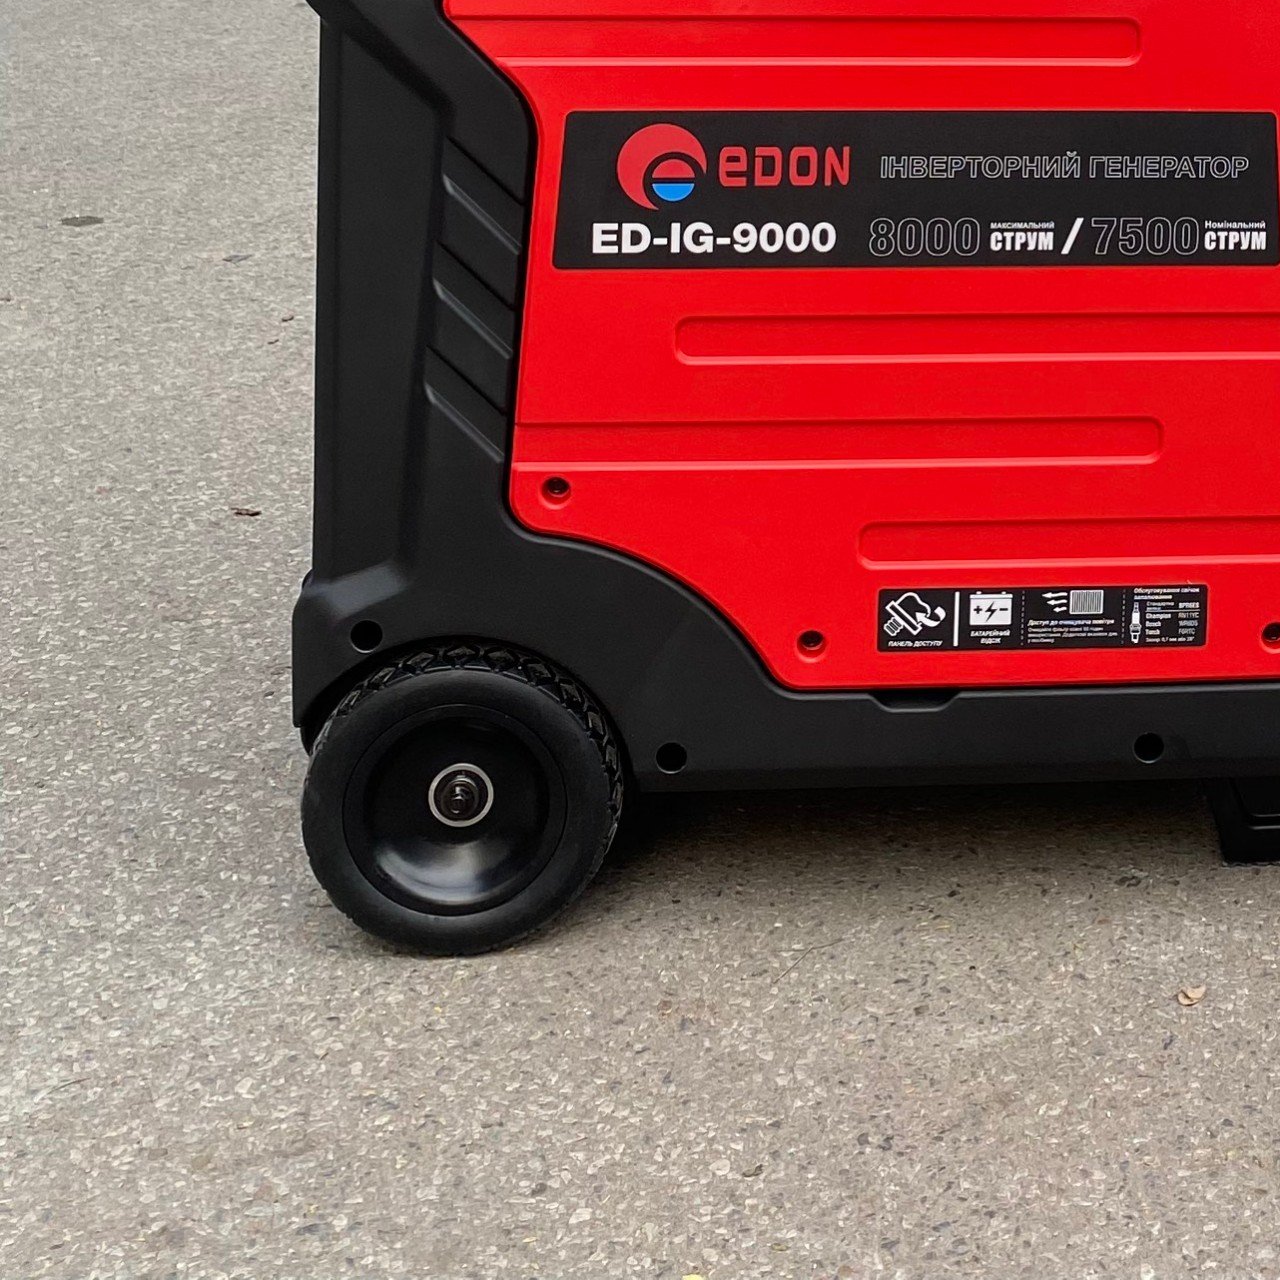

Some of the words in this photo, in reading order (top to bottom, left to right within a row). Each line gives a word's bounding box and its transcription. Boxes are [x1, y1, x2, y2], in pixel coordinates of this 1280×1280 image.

[880, 150, 1081, 179] ІНВЕРТОРНИЙ
[1088, 156, 1250, 179] ГЕНЕРАТОР
[592, 221, 837, 254] ED-IG-9000
[868, 217, 981, 257] 8000
[989, 231, 1055, 252] СТРУМ
[1091, 216, 1200, 256] 7500
[1204, 231, 1267, 251] СТРУМ
